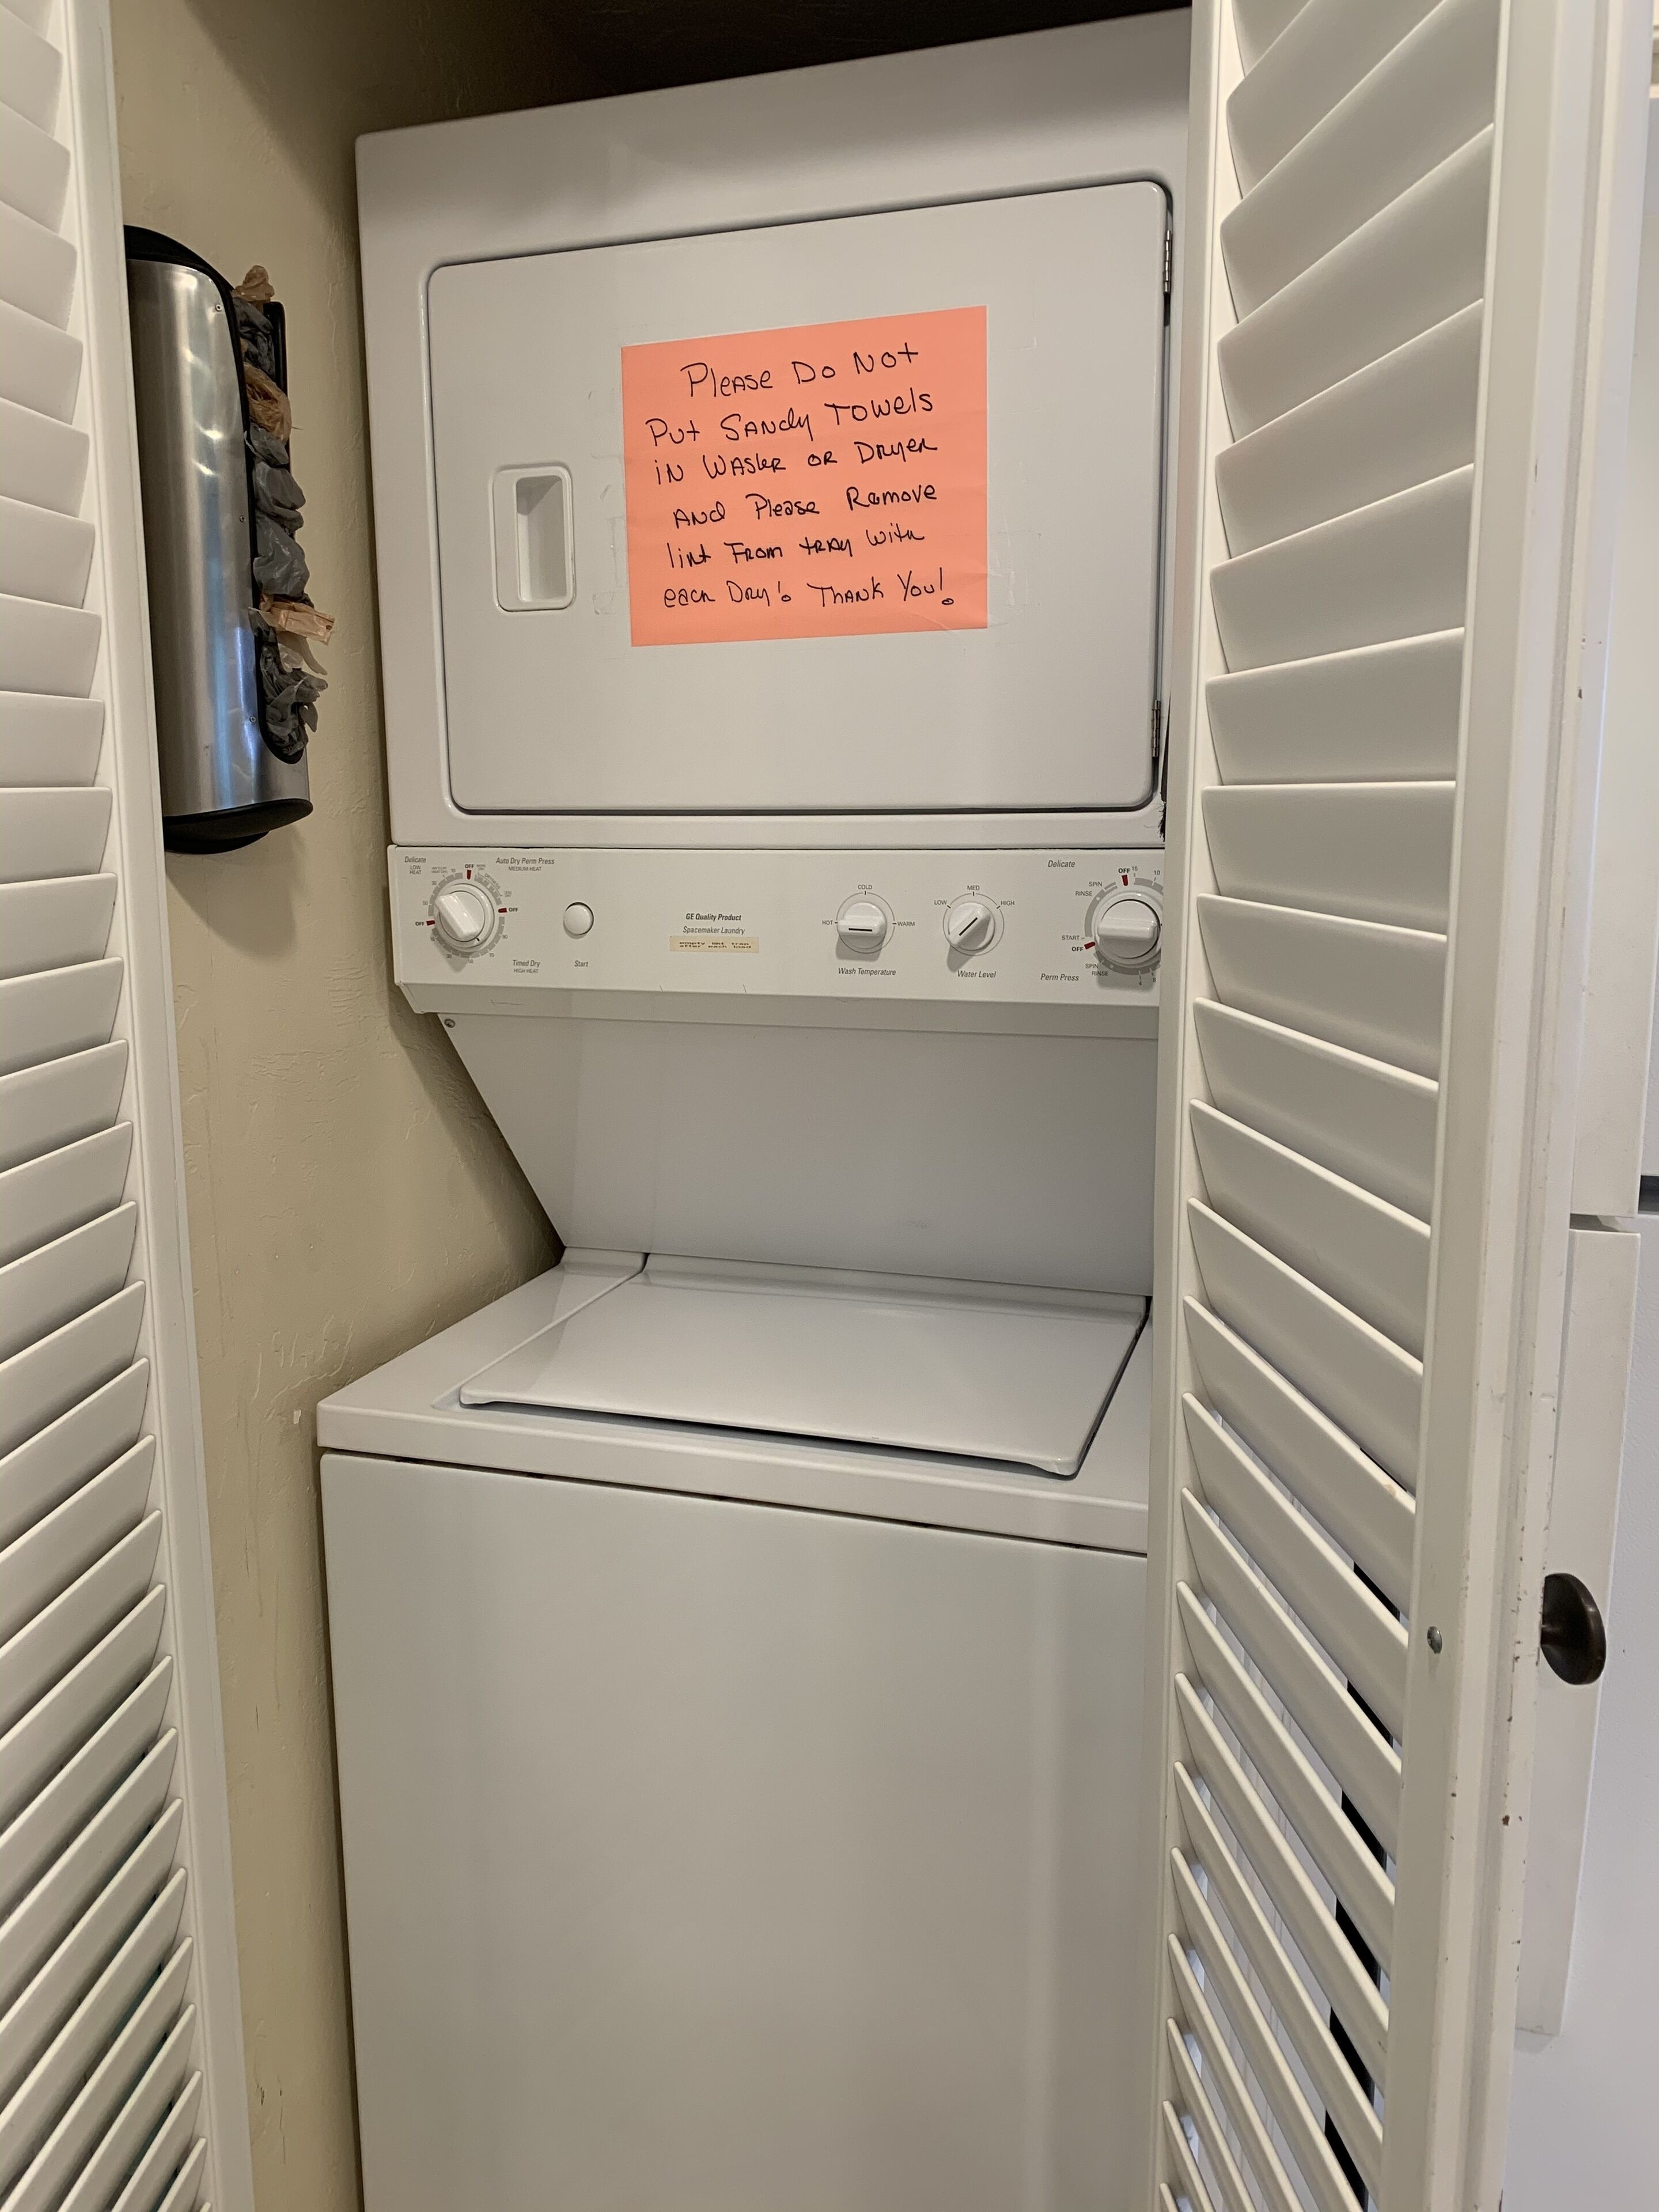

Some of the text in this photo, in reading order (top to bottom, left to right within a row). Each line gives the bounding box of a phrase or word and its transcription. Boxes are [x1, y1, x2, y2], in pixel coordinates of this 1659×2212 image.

[791, 361, 836, 384] Do
[696, 914, 716, 922] Quality
[683, 926, 745, 935] Spacemaker Laundry
